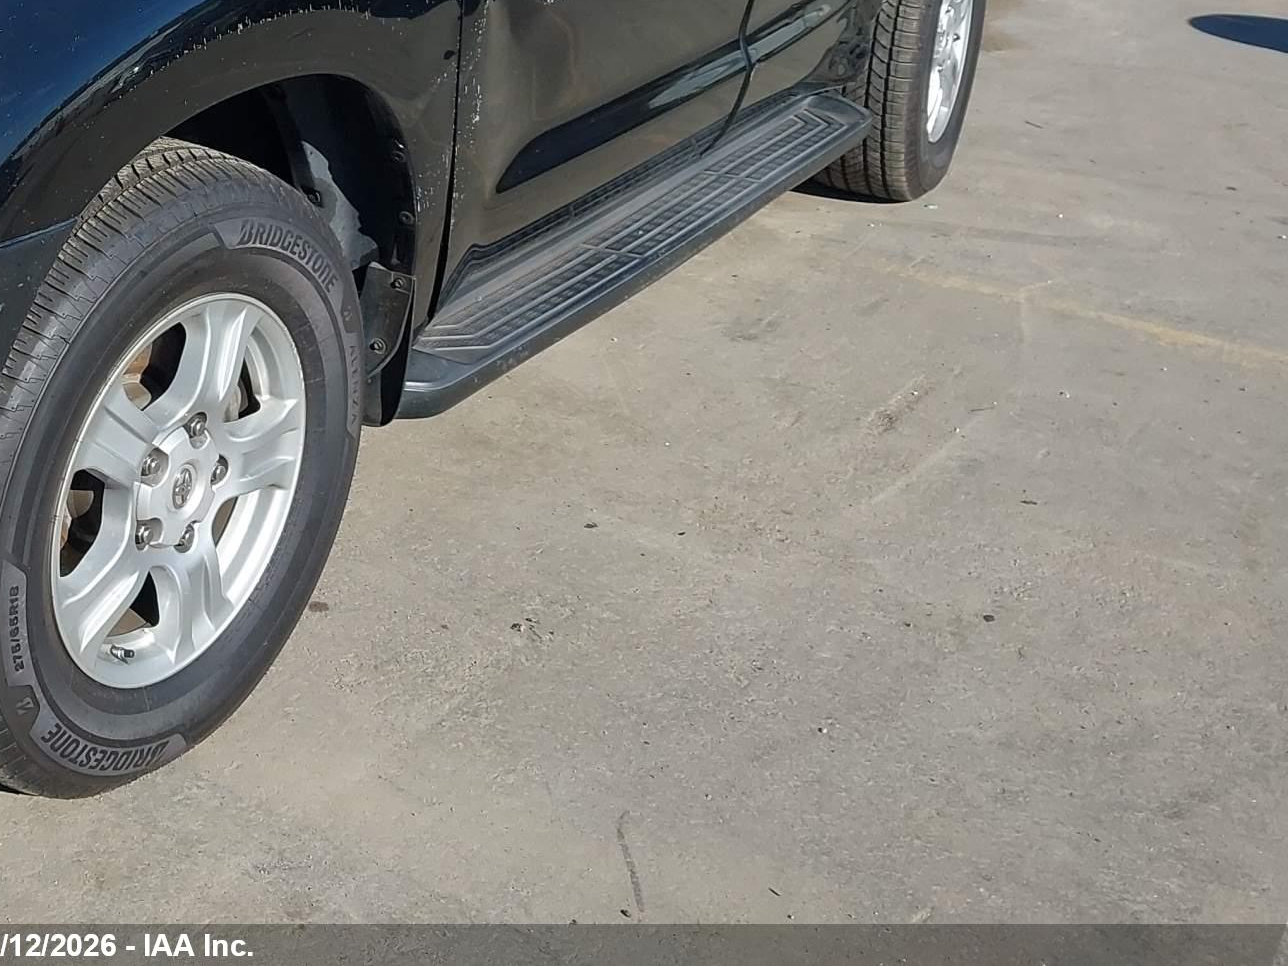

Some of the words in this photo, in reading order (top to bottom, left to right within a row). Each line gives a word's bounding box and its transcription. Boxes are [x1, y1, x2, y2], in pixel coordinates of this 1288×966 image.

[237, 220, 339, 294] BRIDGESTONE
[9, 585, 25, 672] 275/65R18
[41, 722, 170, 772] BRIDGESTONE
